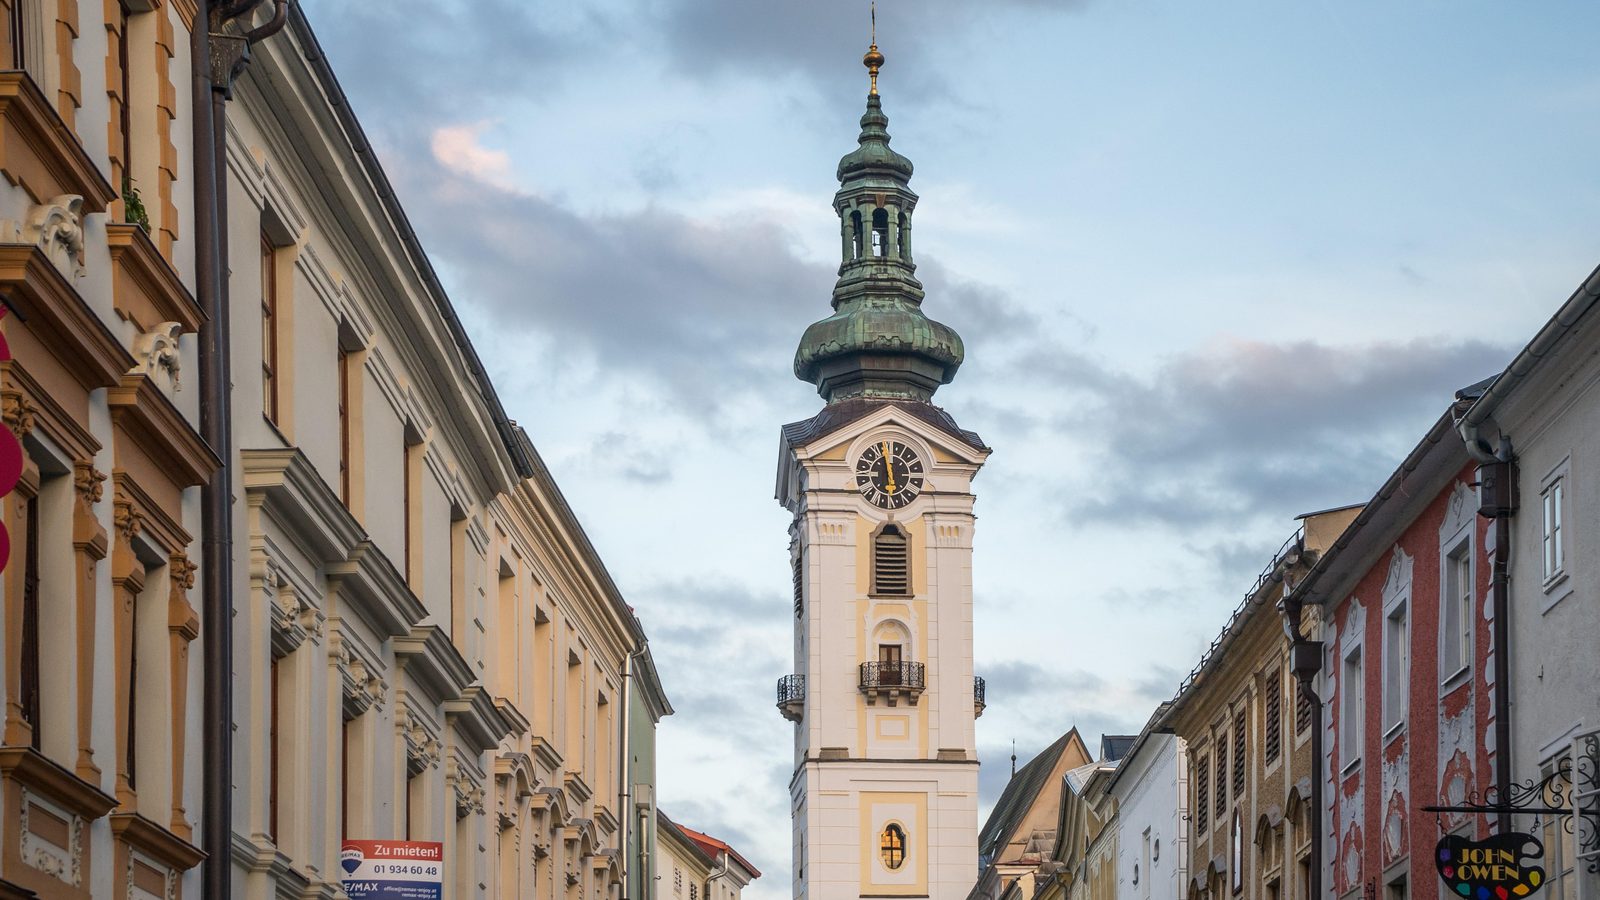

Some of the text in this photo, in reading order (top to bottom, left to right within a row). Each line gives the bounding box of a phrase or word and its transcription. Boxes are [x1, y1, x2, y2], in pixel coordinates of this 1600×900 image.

[374, 844, 438, 858] Zu mieten!
[1457, 849, 1514, 864] JOHN
[374, 865, 437, 876] 01 934 60 48
[1457, 865, 1519, 880] OWEN
[344, 883, 378, 892] E/MAX
